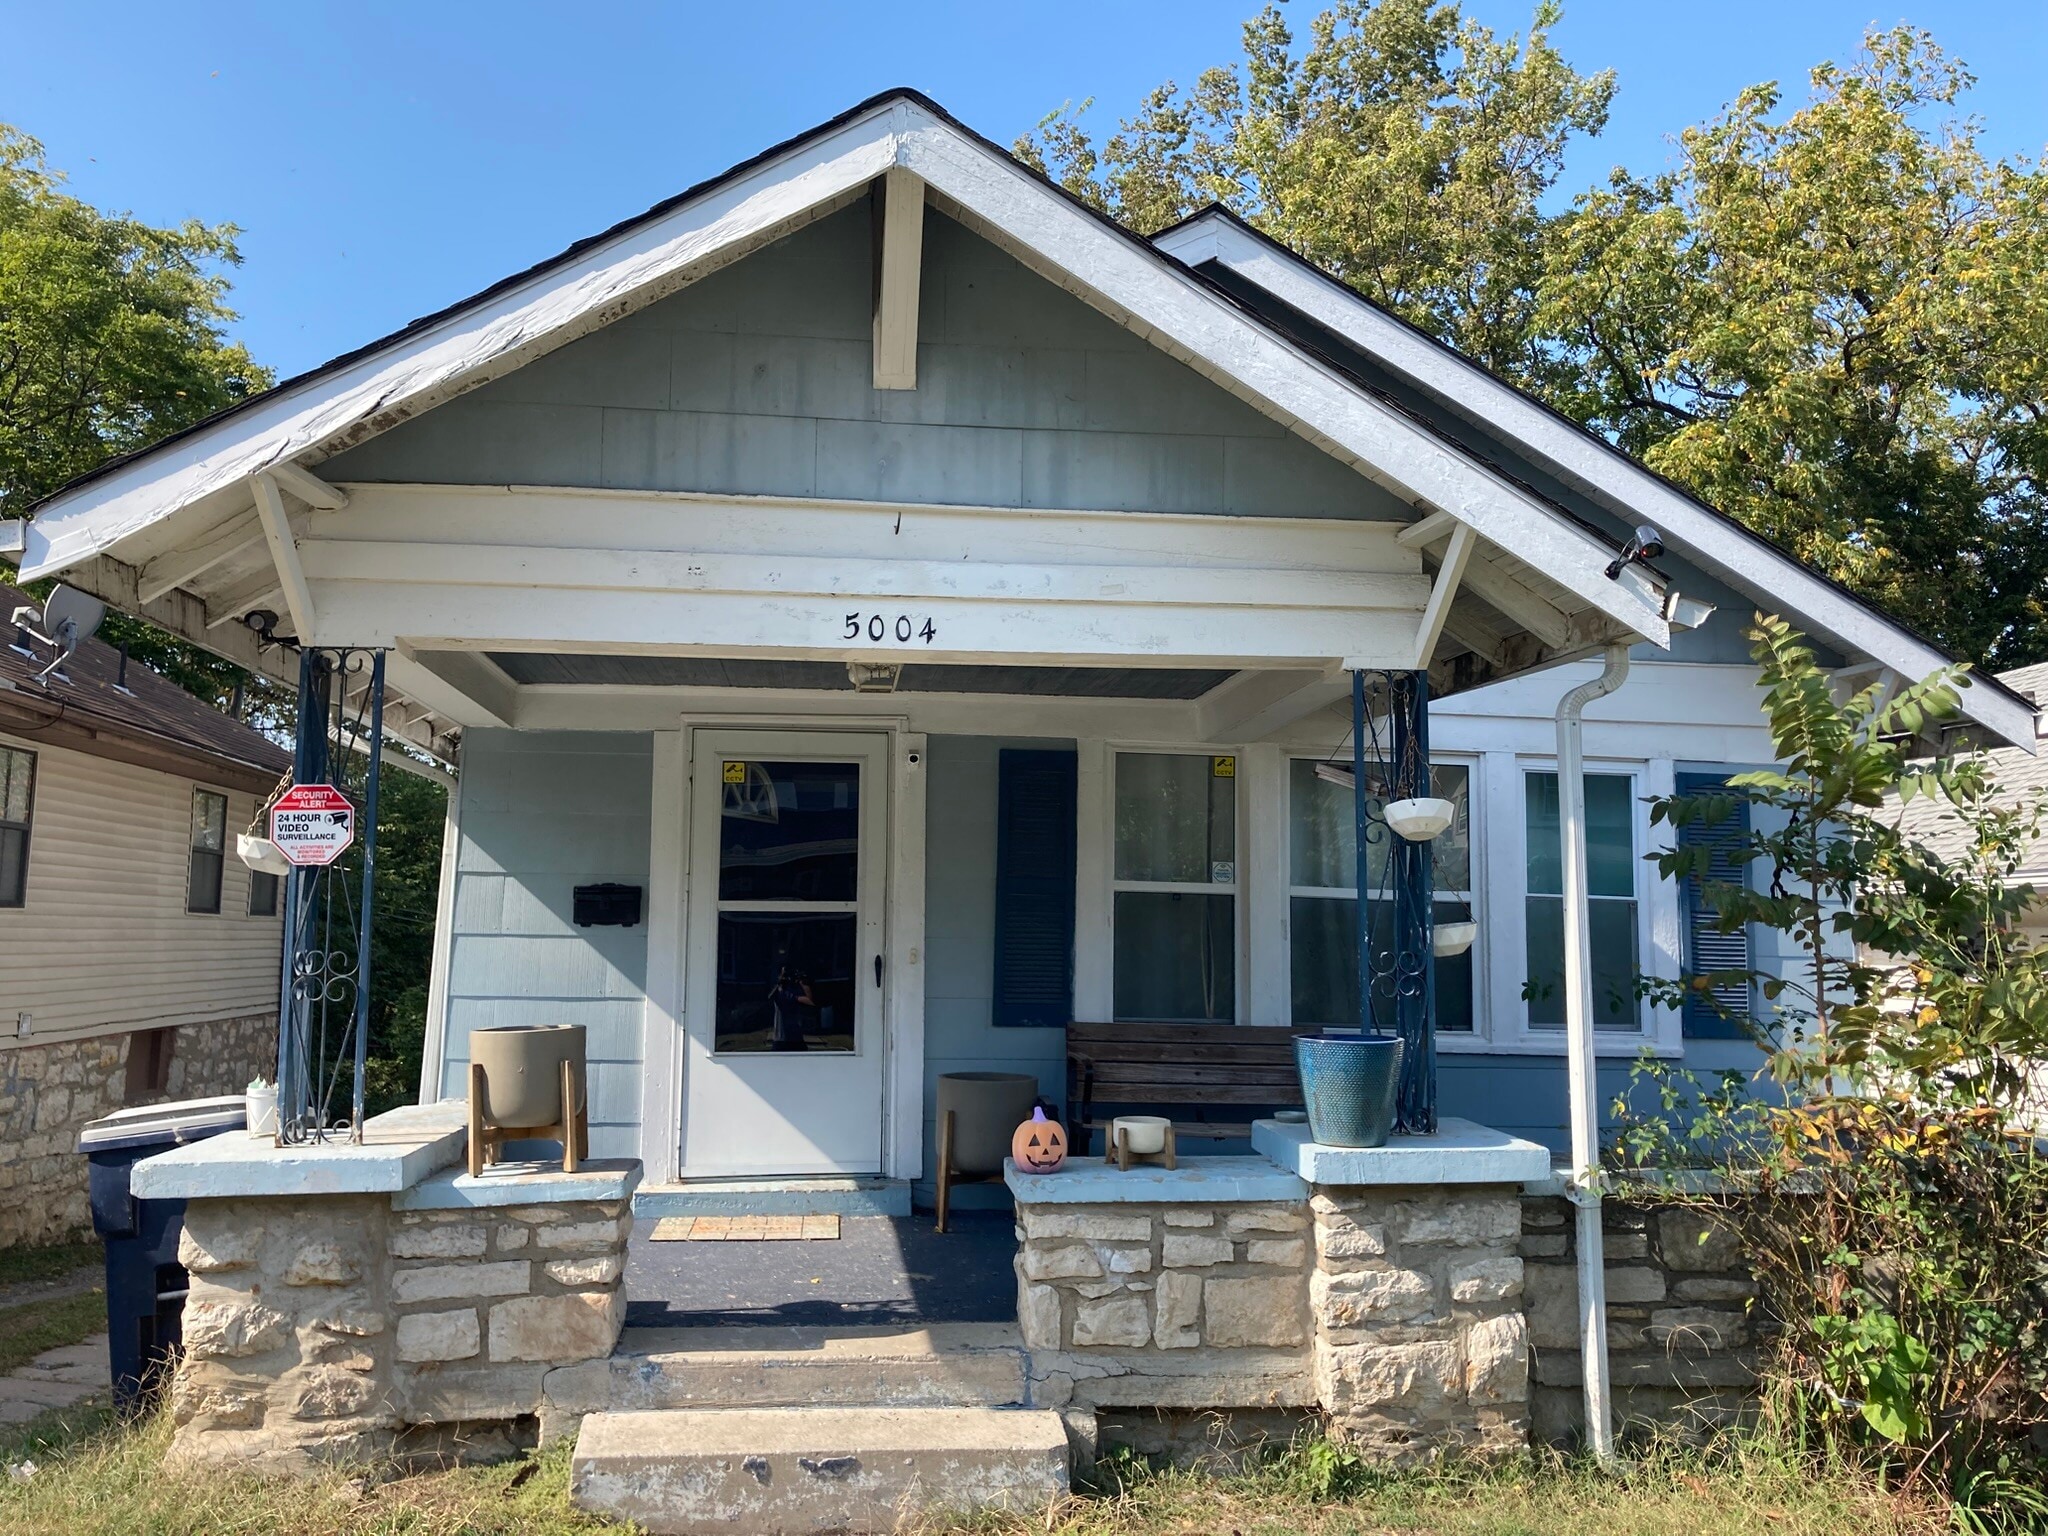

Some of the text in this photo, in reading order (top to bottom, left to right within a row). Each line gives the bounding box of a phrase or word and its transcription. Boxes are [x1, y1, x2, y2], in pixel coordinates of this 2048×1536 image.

[843, 612, 937, 645] 5004
[291, 791, 334, 799] SECURITY
[299, 800, 327, 808] ALERT
[278, 814, 321, 822] 24 HOUR
[278, 824, 309, 832] VIDEO
[277, 833, 336, 841] SURVEILLANCE
